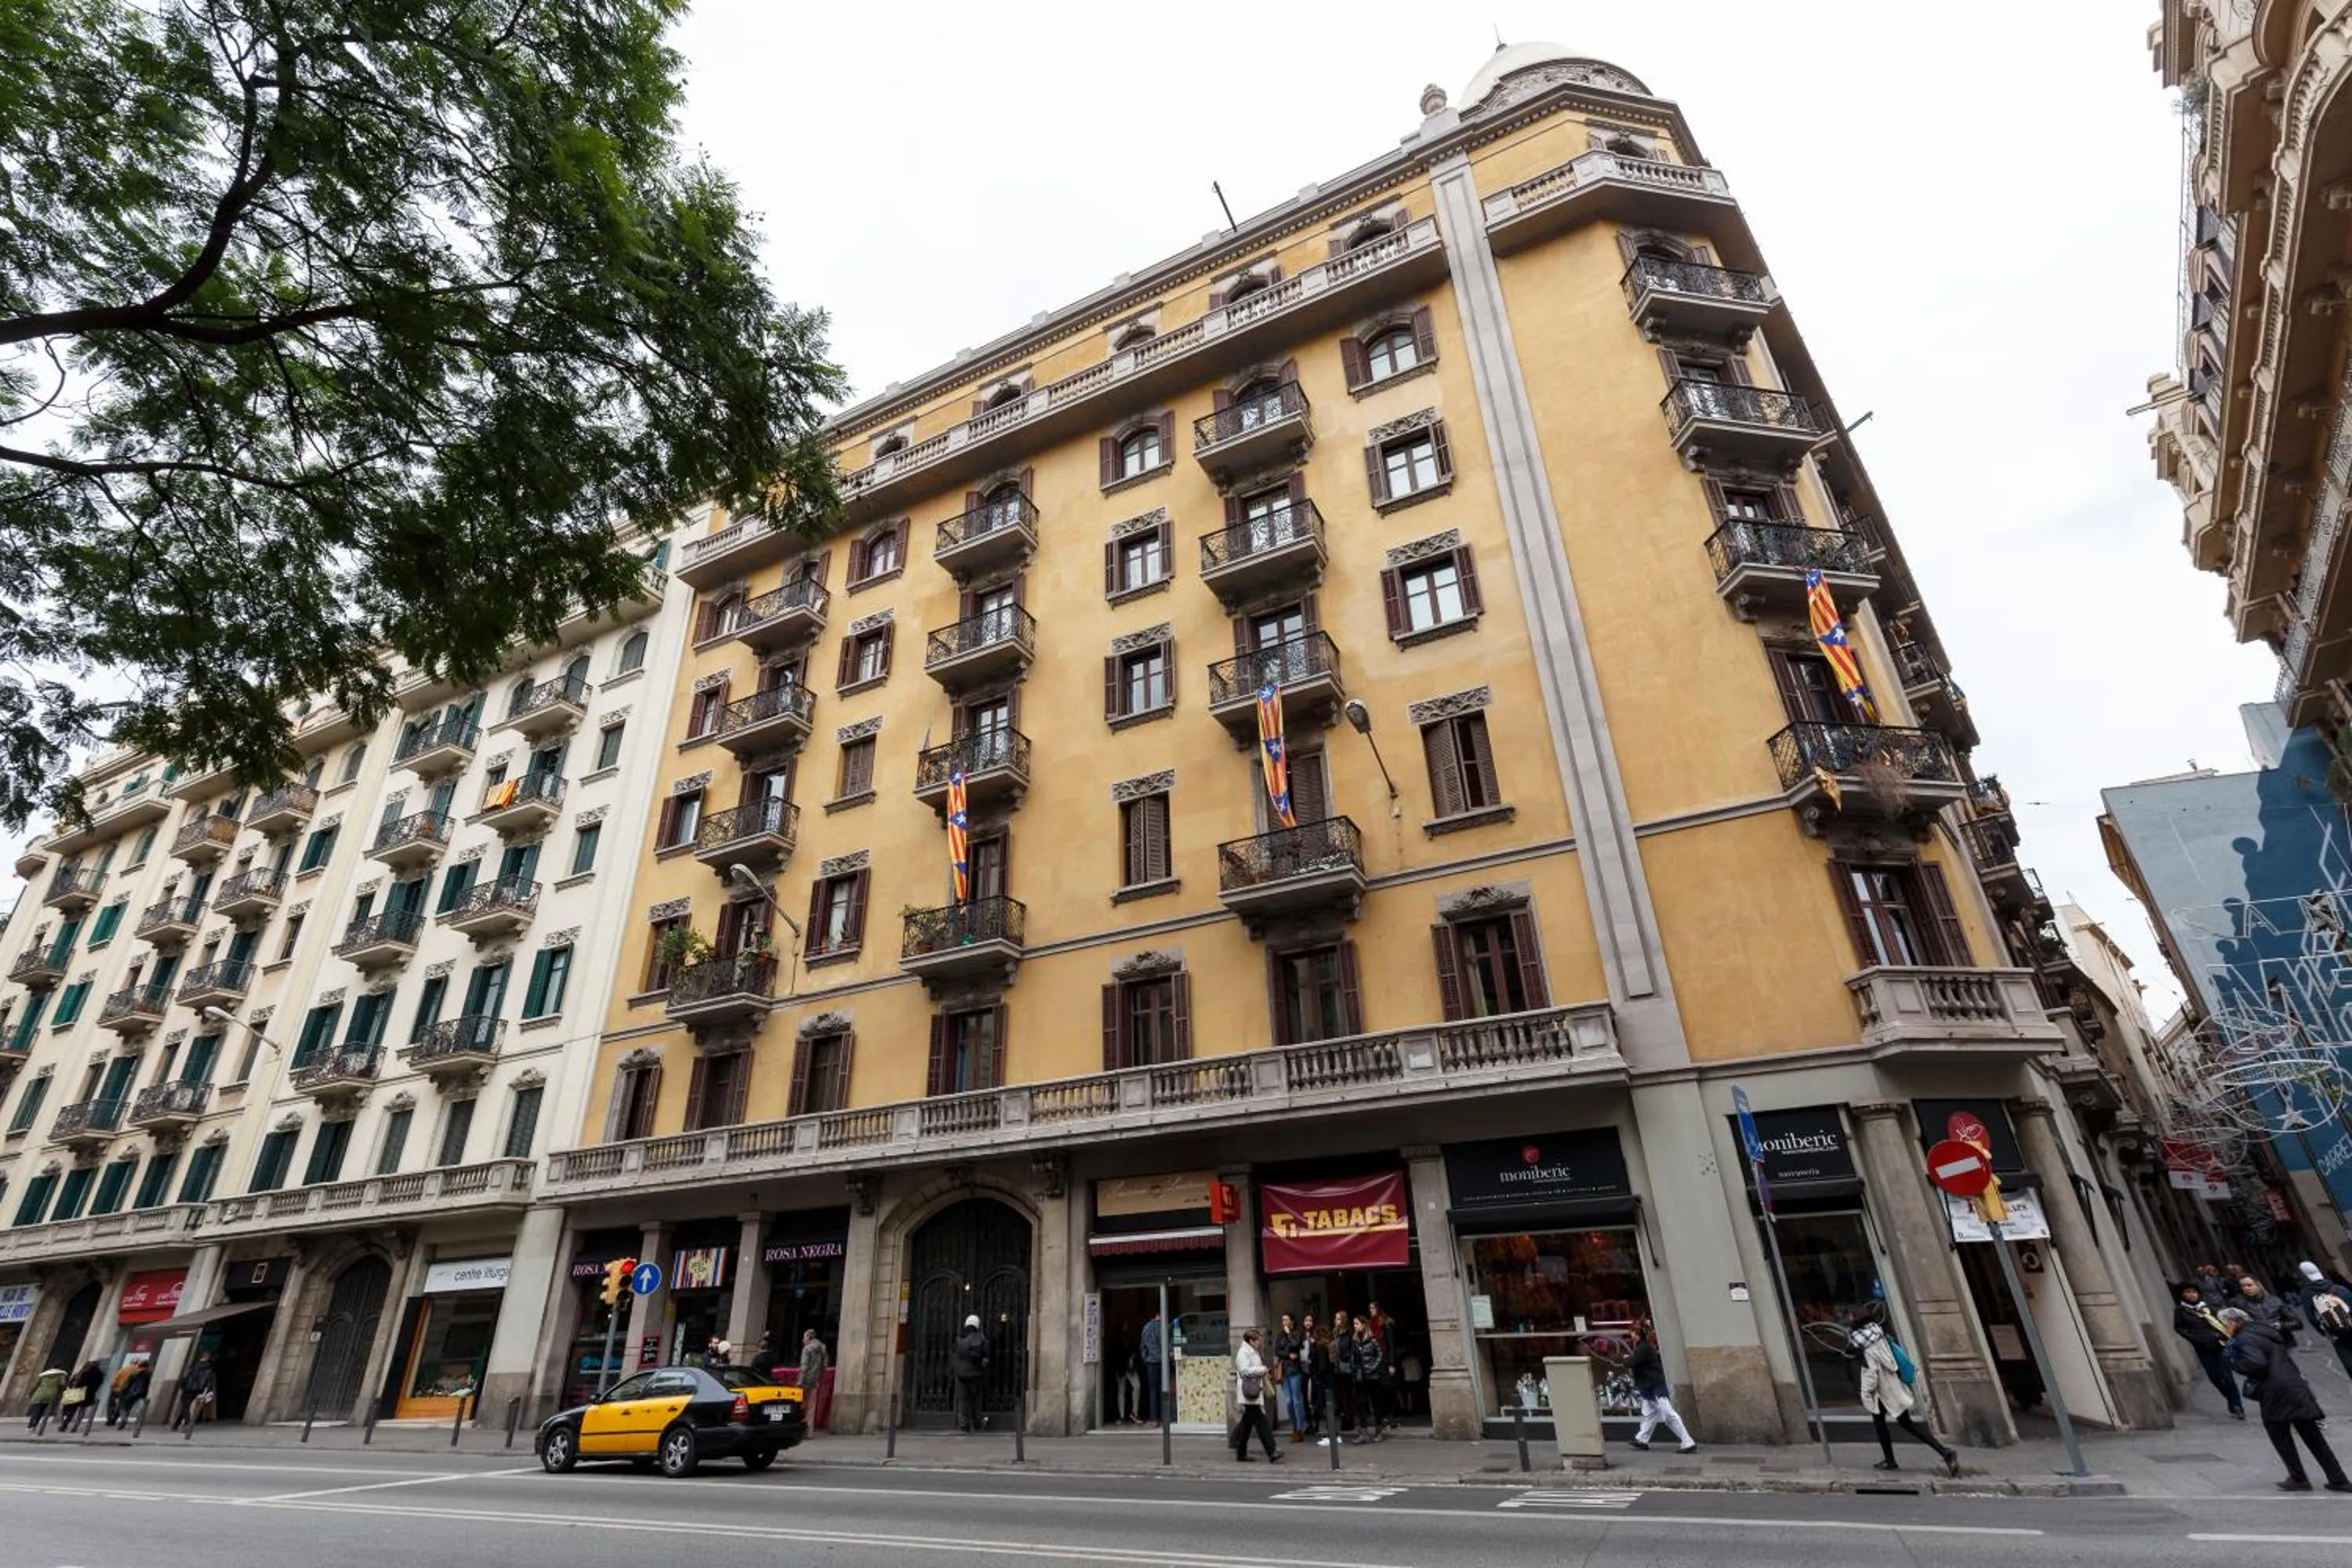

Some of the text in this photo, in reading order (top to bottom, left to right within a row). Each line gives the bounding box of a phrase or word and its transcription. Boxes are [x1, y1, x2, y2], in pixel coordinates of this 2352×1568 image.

[1499, 1163, 1570, 1183] moniberic
[1302, 1203, 1399, 1230] TABACS
[765, 1243, 842, 1261] ROSA NEGRA
[572, 1263, 600, 1276] ROSA
